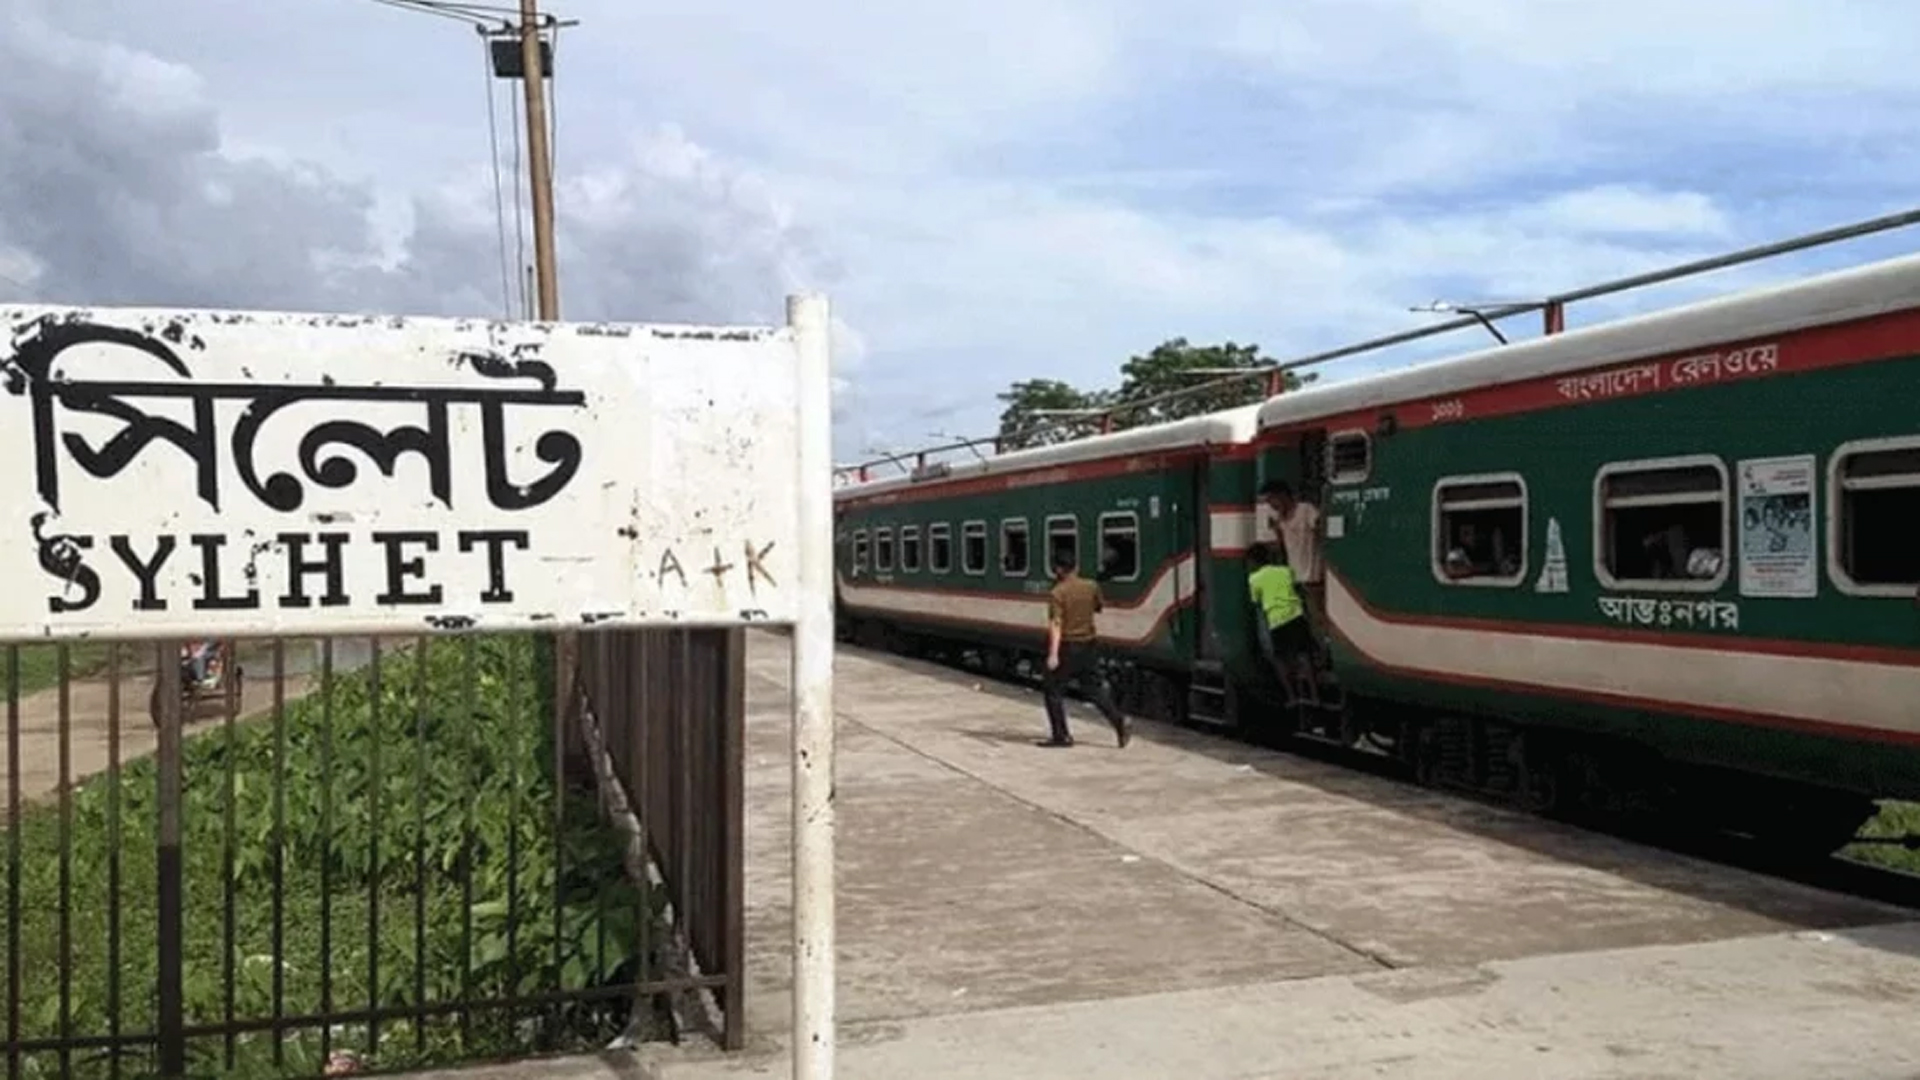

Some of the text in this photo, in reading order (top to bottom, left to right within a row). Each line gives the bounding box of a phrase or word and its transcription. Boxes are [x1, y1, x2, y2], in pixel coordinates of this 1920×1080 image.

[1556, 344, 1779, 399] বাংলাদেশ রেলওয়ে
[14, 320, 587, 514] সিলেট
[37, 528, 529, 613] SYLHET
